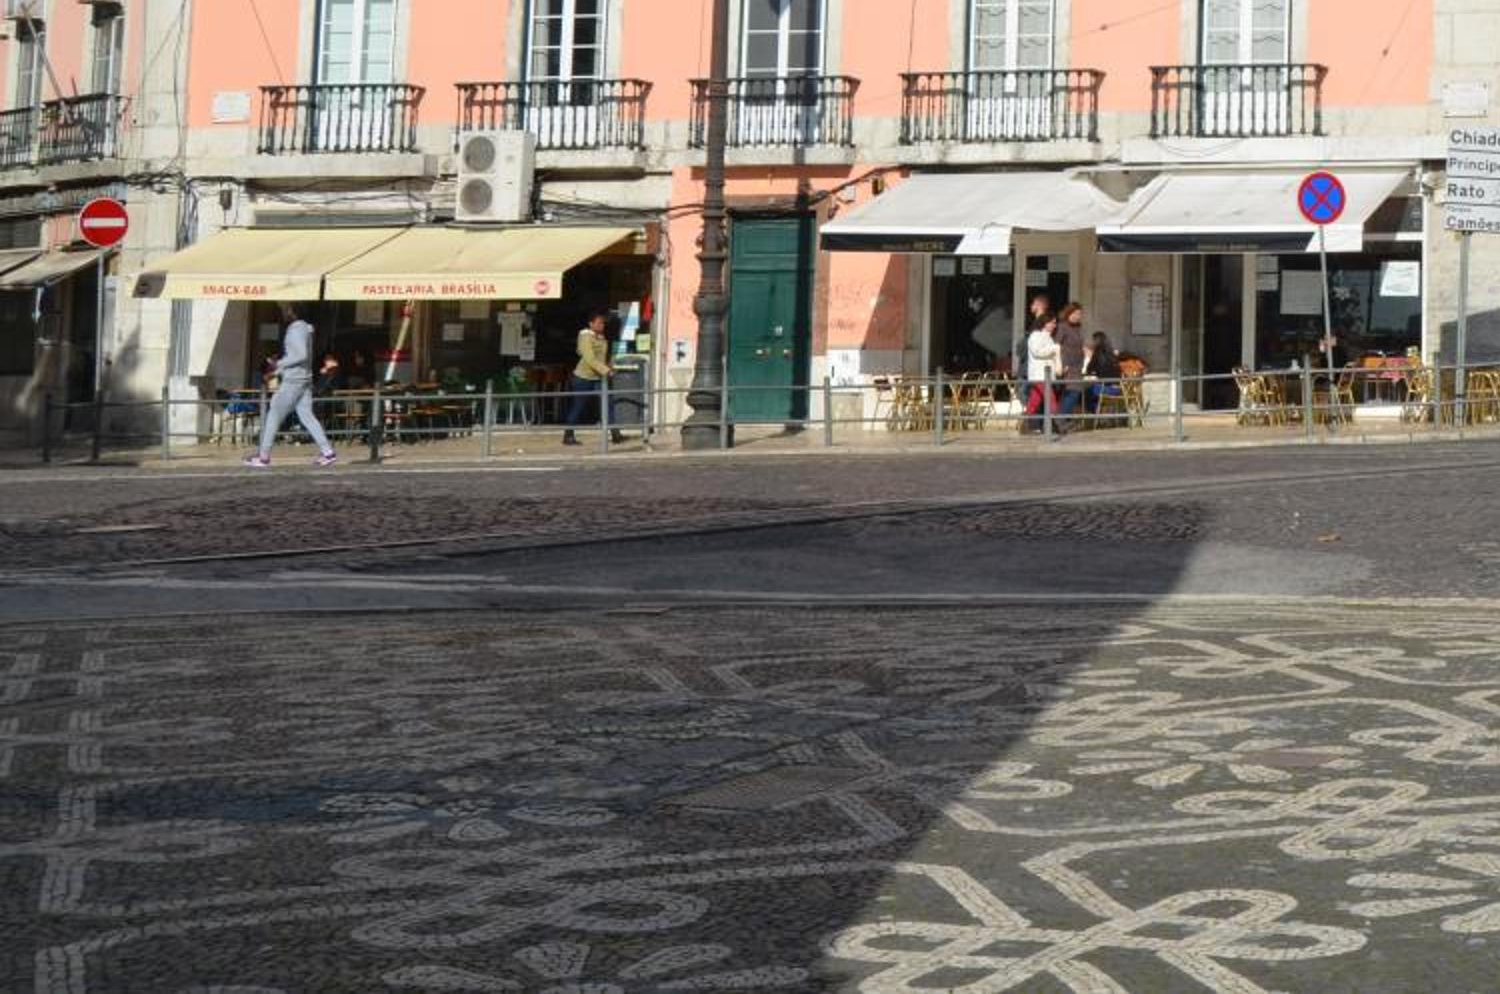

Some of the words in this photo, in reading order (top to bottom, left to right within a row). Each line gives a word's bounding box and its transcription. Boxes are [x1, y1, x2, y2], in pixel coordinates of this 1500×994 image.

[1447, 183, 1485, 199] Rato
[1446, 215, 1500, 231] Camões
[363, 285, 434, 295] PASTELARIA
